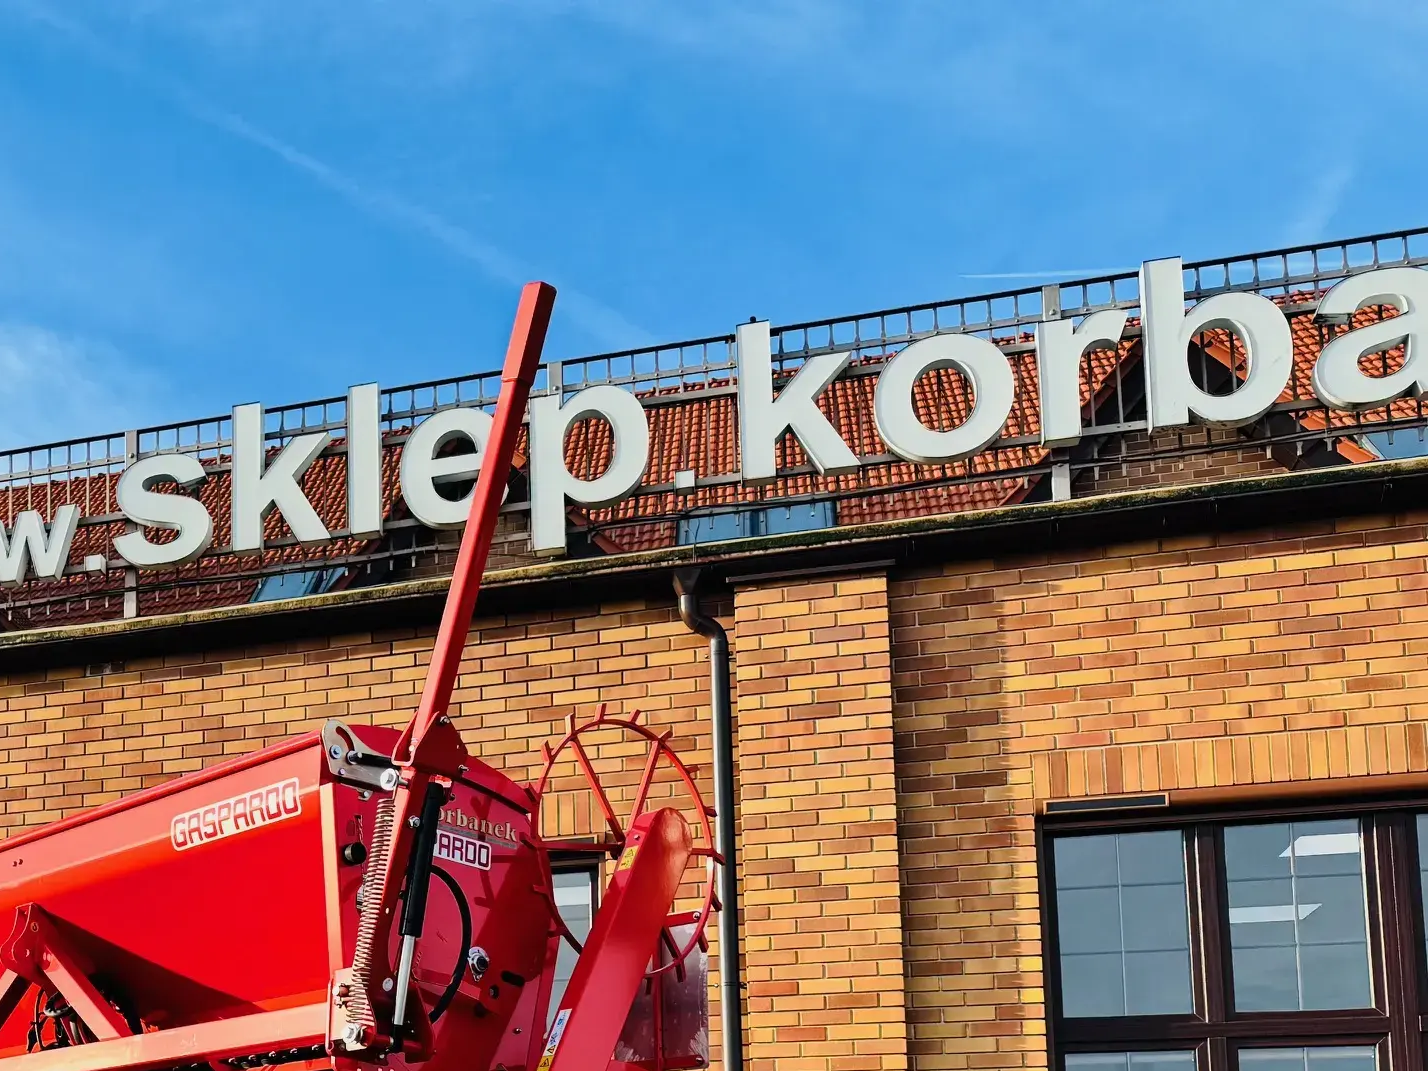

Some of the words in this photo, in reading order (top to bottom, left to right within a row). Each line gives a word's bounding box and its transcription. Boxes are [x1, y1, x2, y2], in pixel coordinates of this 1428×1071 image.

[173, 781, 299, 848] GASPARDO
[438, 807, 518, 842] orbanek
[438, 833, 491, 868] ARDO
